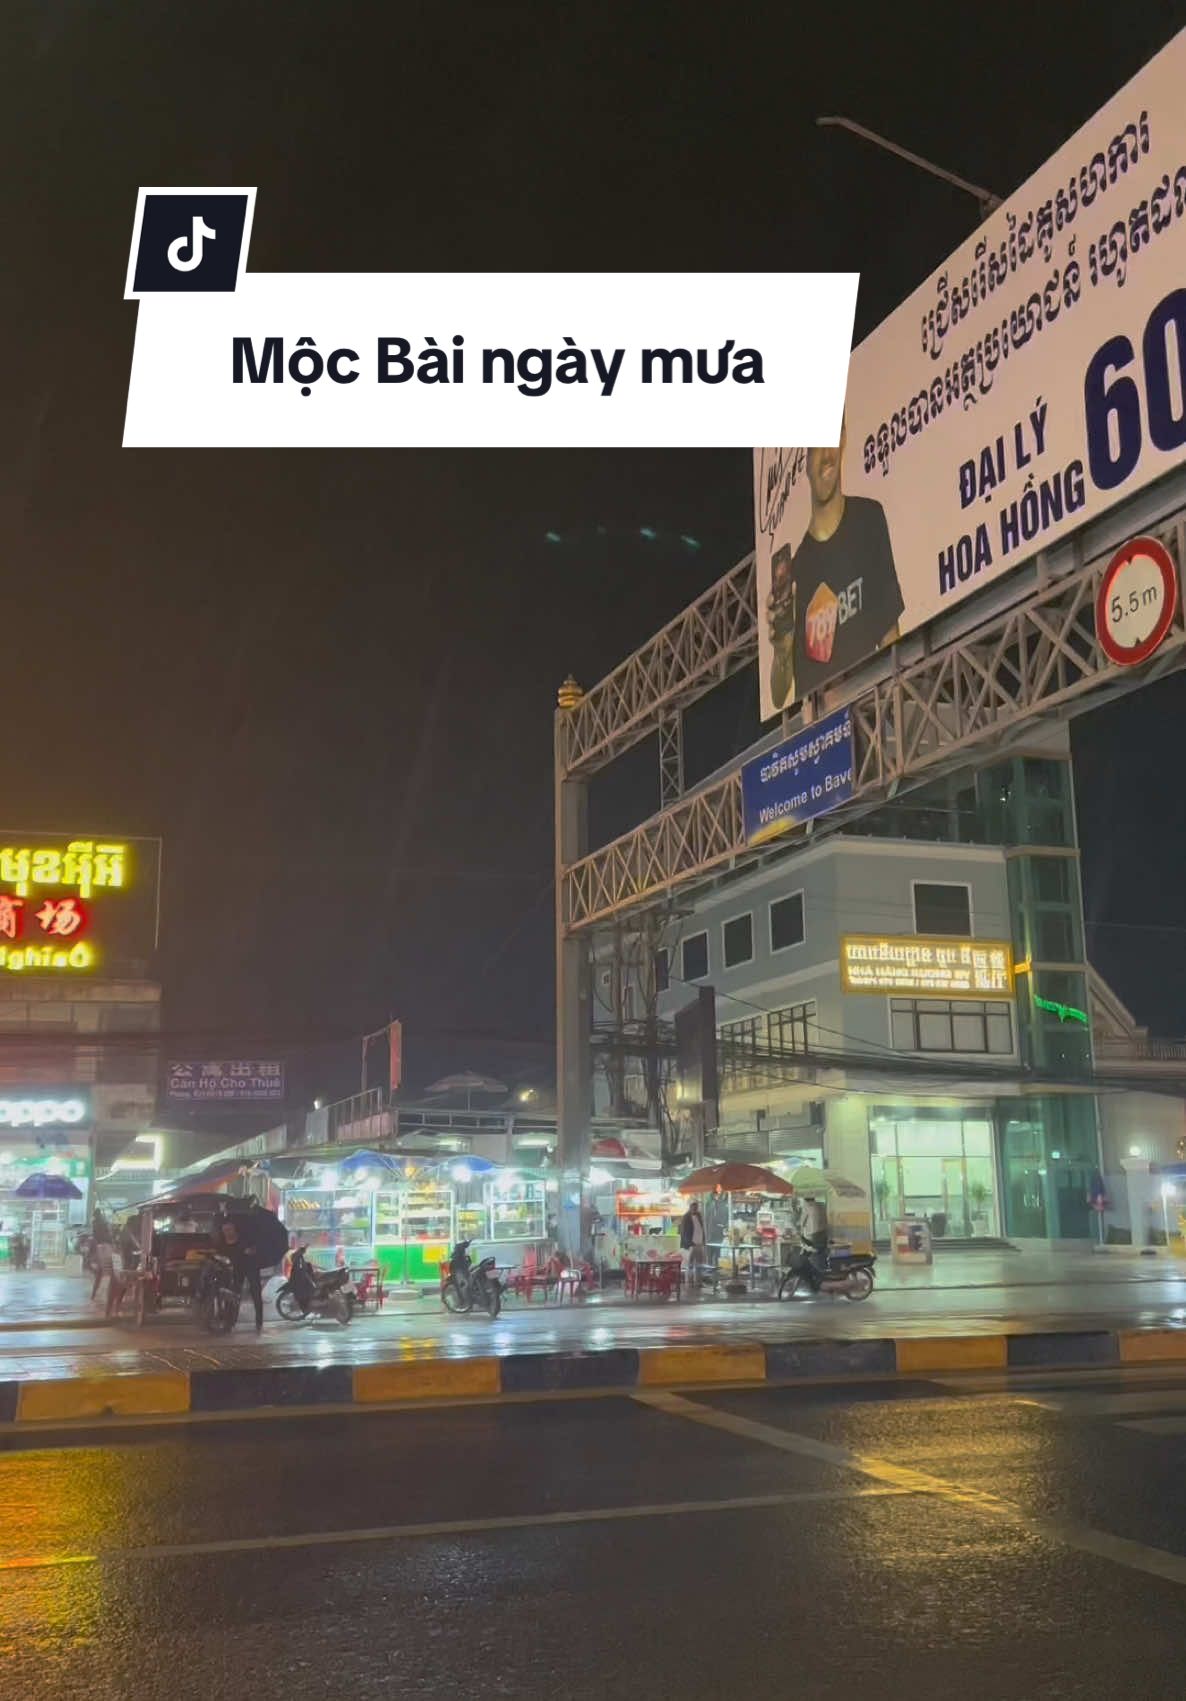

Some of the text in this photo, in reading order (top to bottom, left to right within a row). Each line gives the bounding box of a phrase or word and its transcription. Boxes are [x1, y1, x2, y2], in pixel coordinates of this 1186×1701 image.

[1083, 288, 1186, 491] 60
[958, 395, 1048, 509] ĐẠI LÝ
[938, 472, 1086, 595] HOA HỒNG
[759, 790, 809, 824] Welcome
[810, 784, 823, 801] to
[220, 1077, 246, 1089] Cho
